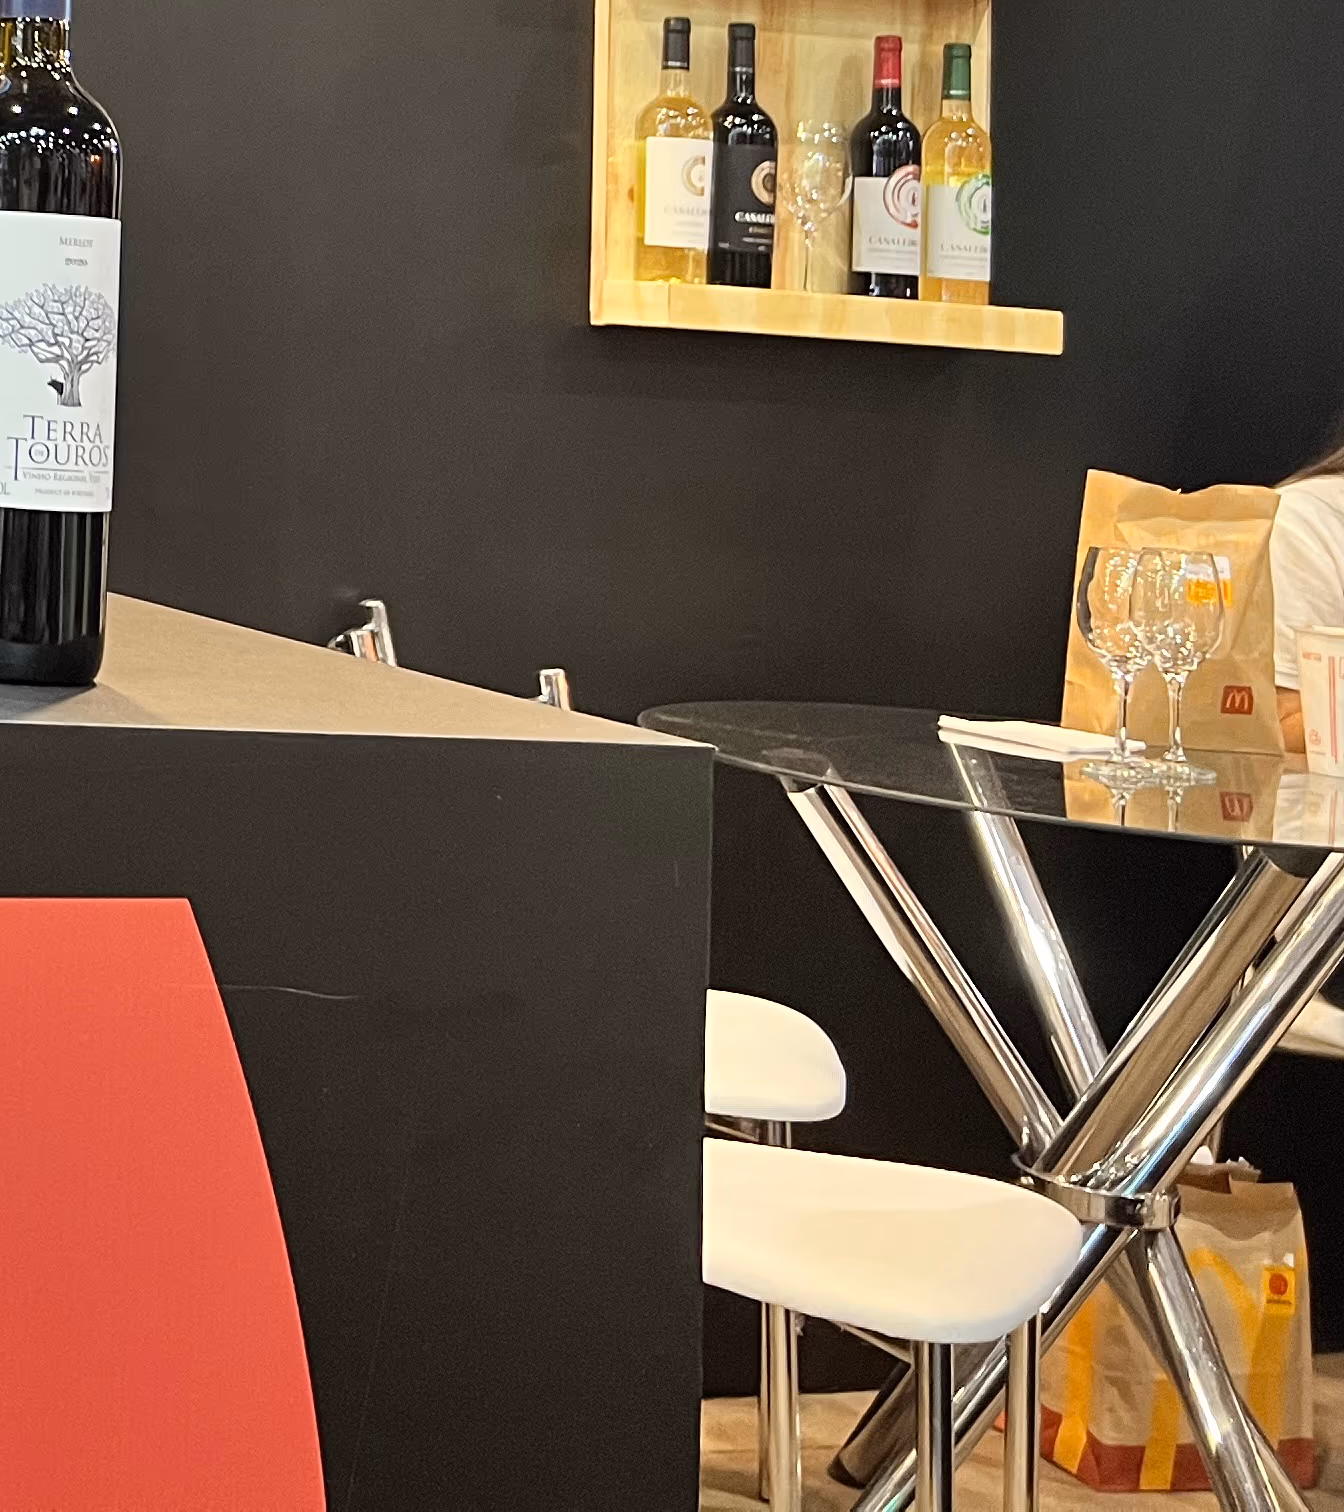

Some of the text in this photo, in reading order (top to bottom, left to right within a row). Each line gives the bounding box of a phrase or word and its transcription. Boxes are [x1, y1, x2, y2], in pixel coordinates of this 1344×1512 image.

[59, 235, 94, 248] MERLOT
[23, 414, 103, 444] TERRA
[7, 437, 109, 481] TOUROS
